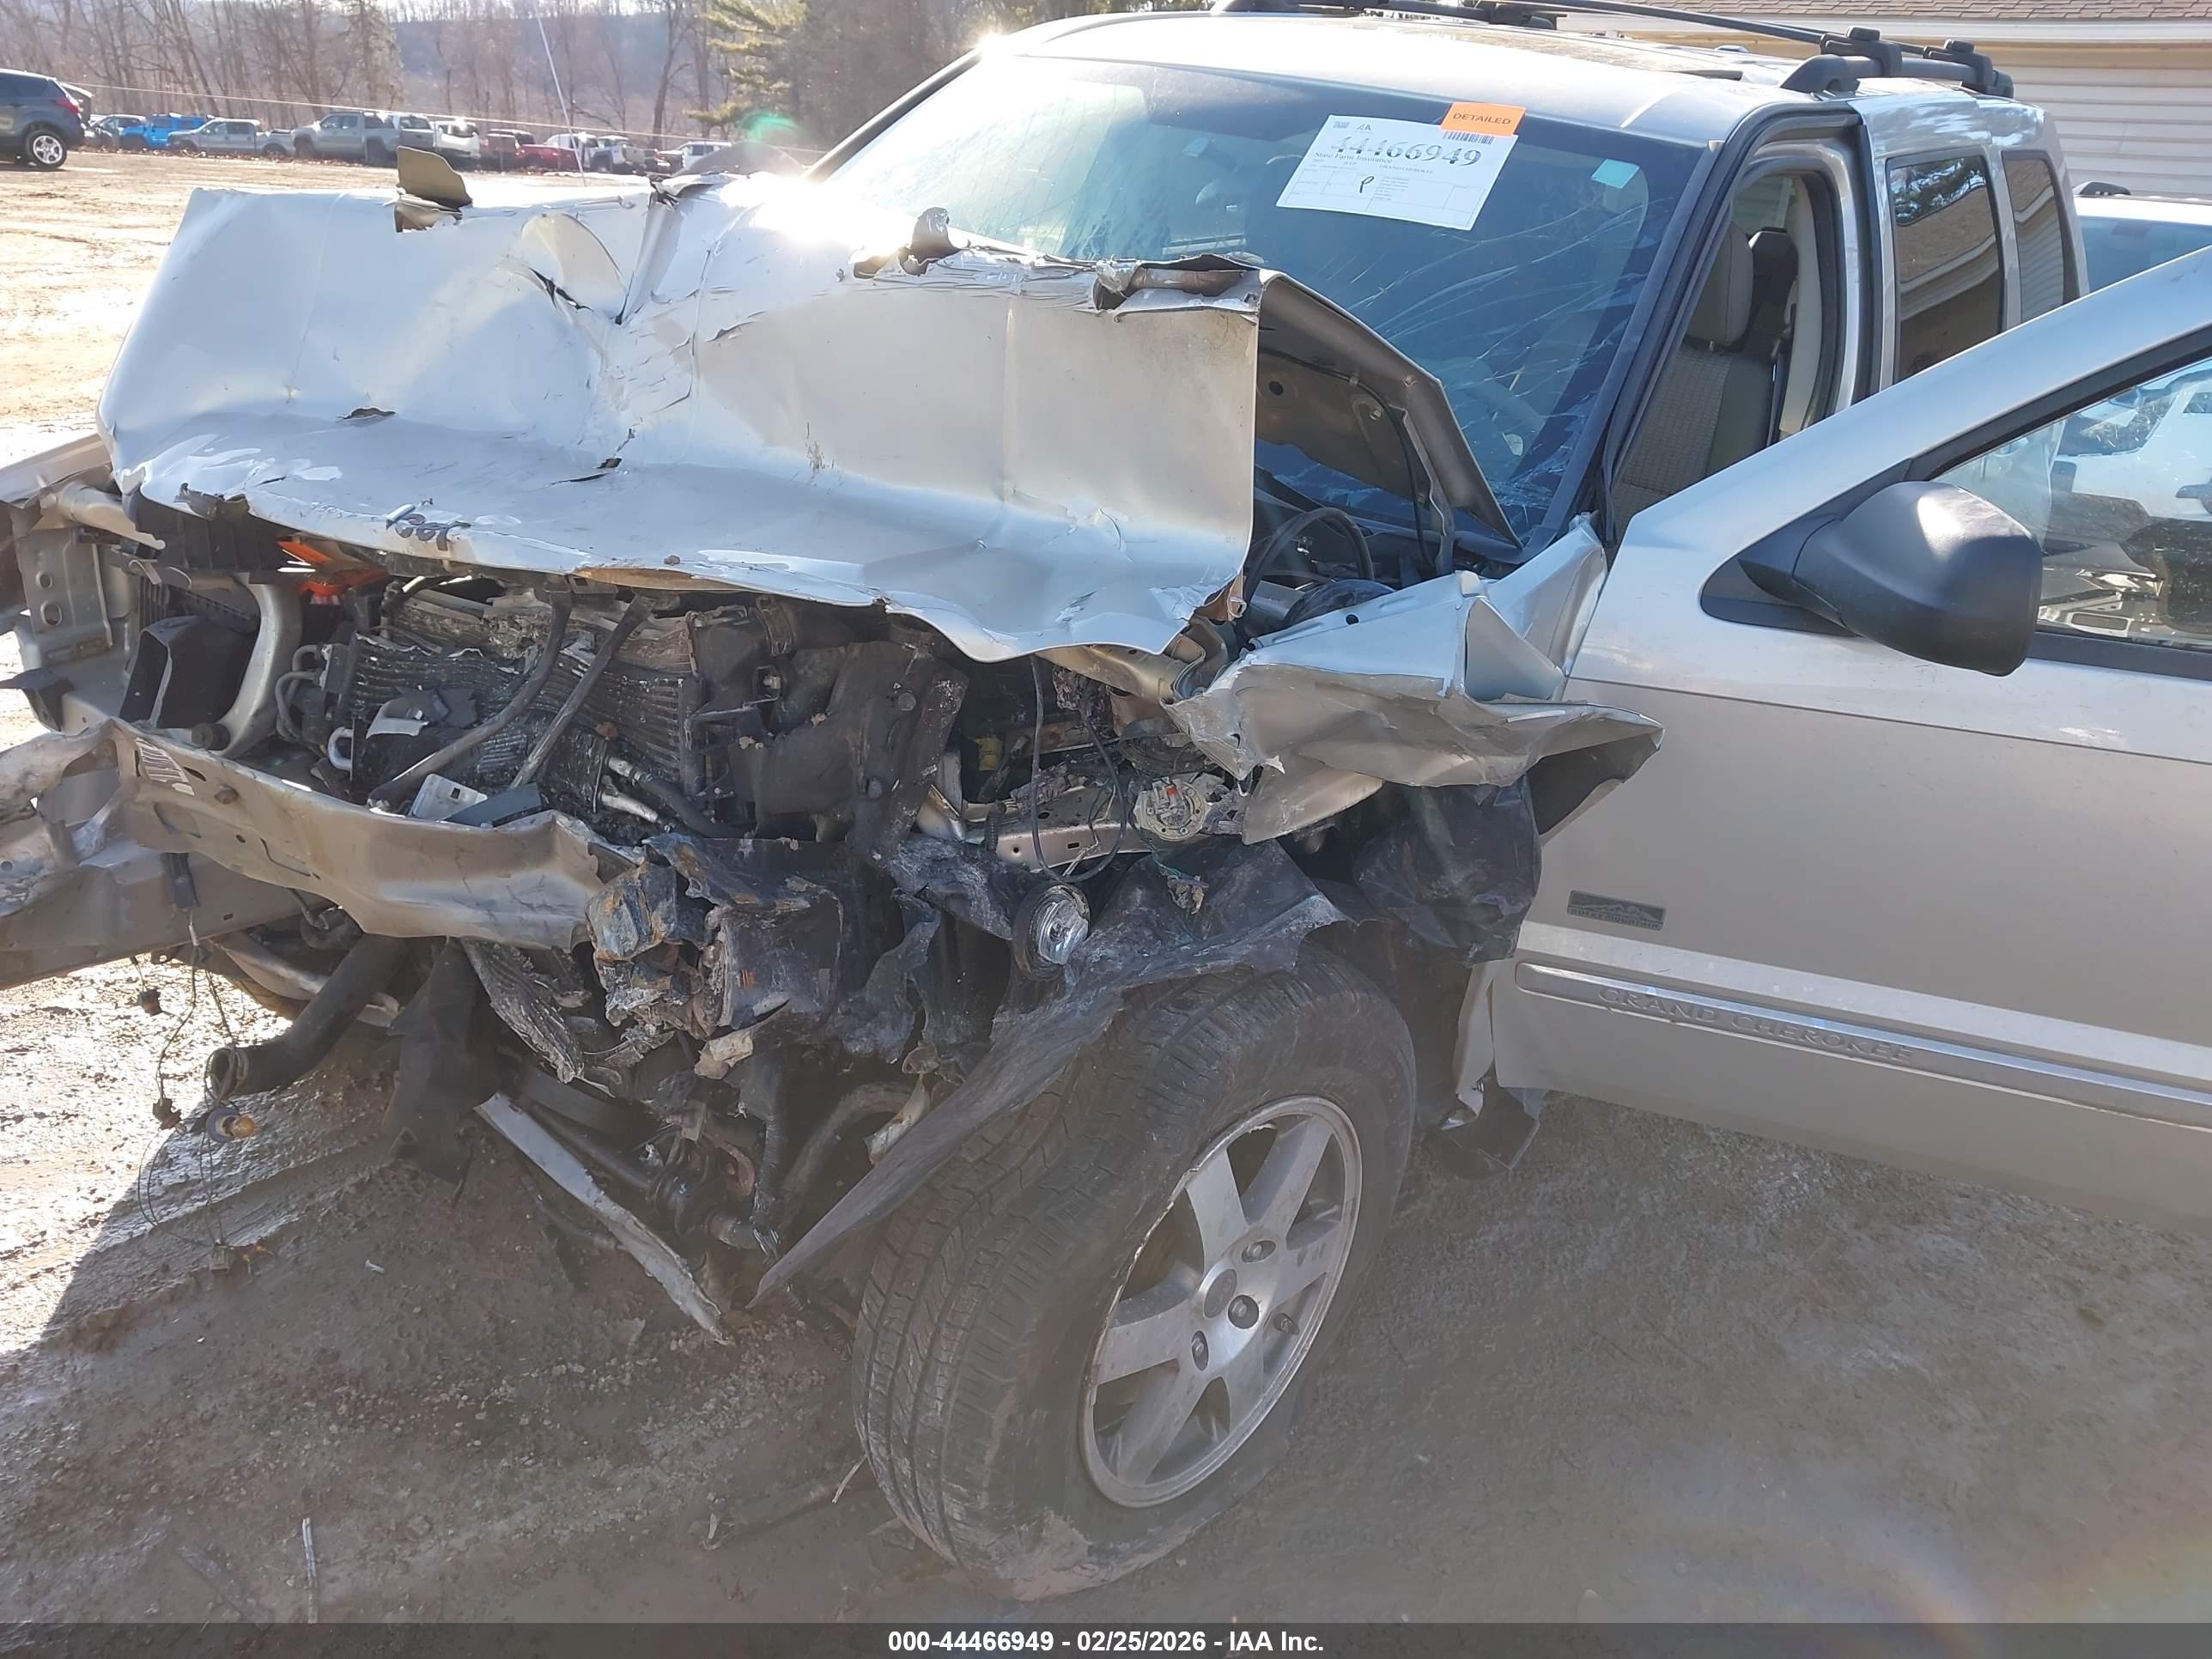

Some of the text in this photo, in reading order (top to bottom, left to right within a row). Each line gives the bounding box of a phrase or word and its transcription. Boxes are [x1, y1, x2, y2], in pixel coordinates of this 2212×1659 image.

[1453, 112, 1511, 125] DETAILED
[1331, 136, 1482, 167] 44466949
[1597, 986, 1914, 1063] GRAND CHEROKEE
